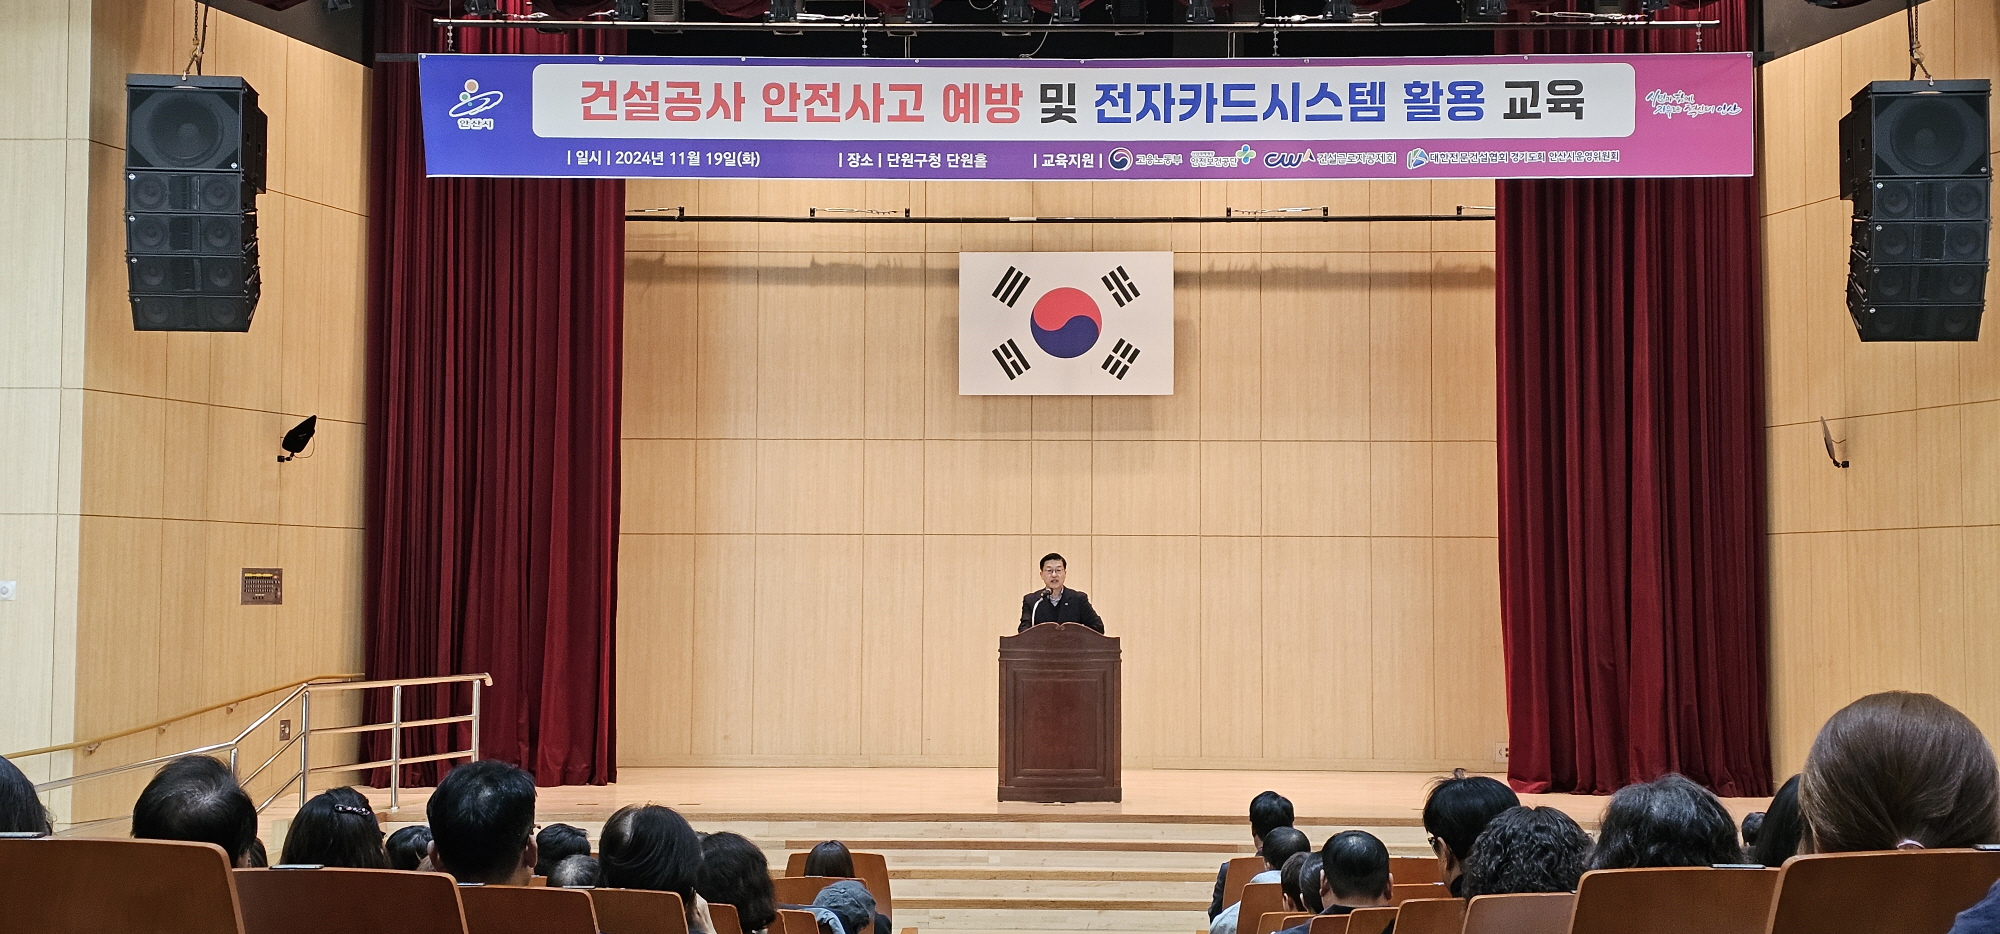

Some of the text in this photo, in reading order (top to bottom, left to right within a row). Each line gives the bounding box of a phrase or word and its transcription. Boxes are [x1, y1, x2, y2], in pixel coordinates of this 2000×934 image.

[580, 79, 1585, 124] 건설공사 안전사고 예방 및 전자카드시스템 활용 교육
[458, 118, 494, 130] 안산시
[575, 150, 602, 166] 일시
[615, 150, 761, 168] 2024년 11월 19일(화)
[846, 152, 874, 168] 장소
[887, 152, 988, 169] 단원구청 단원홀
[1041, 153, 1094, 169] 교육지원
[1136, 154, 1183, 166] 고용노동부
[1190, 157, 1238, 167] 안전보건공단
[1317, 152, 1397, 166] 건설근로자공제회
[1429, 150, 1620, 164] 대한전문건설협회 경기도회 안산시운영위원회
